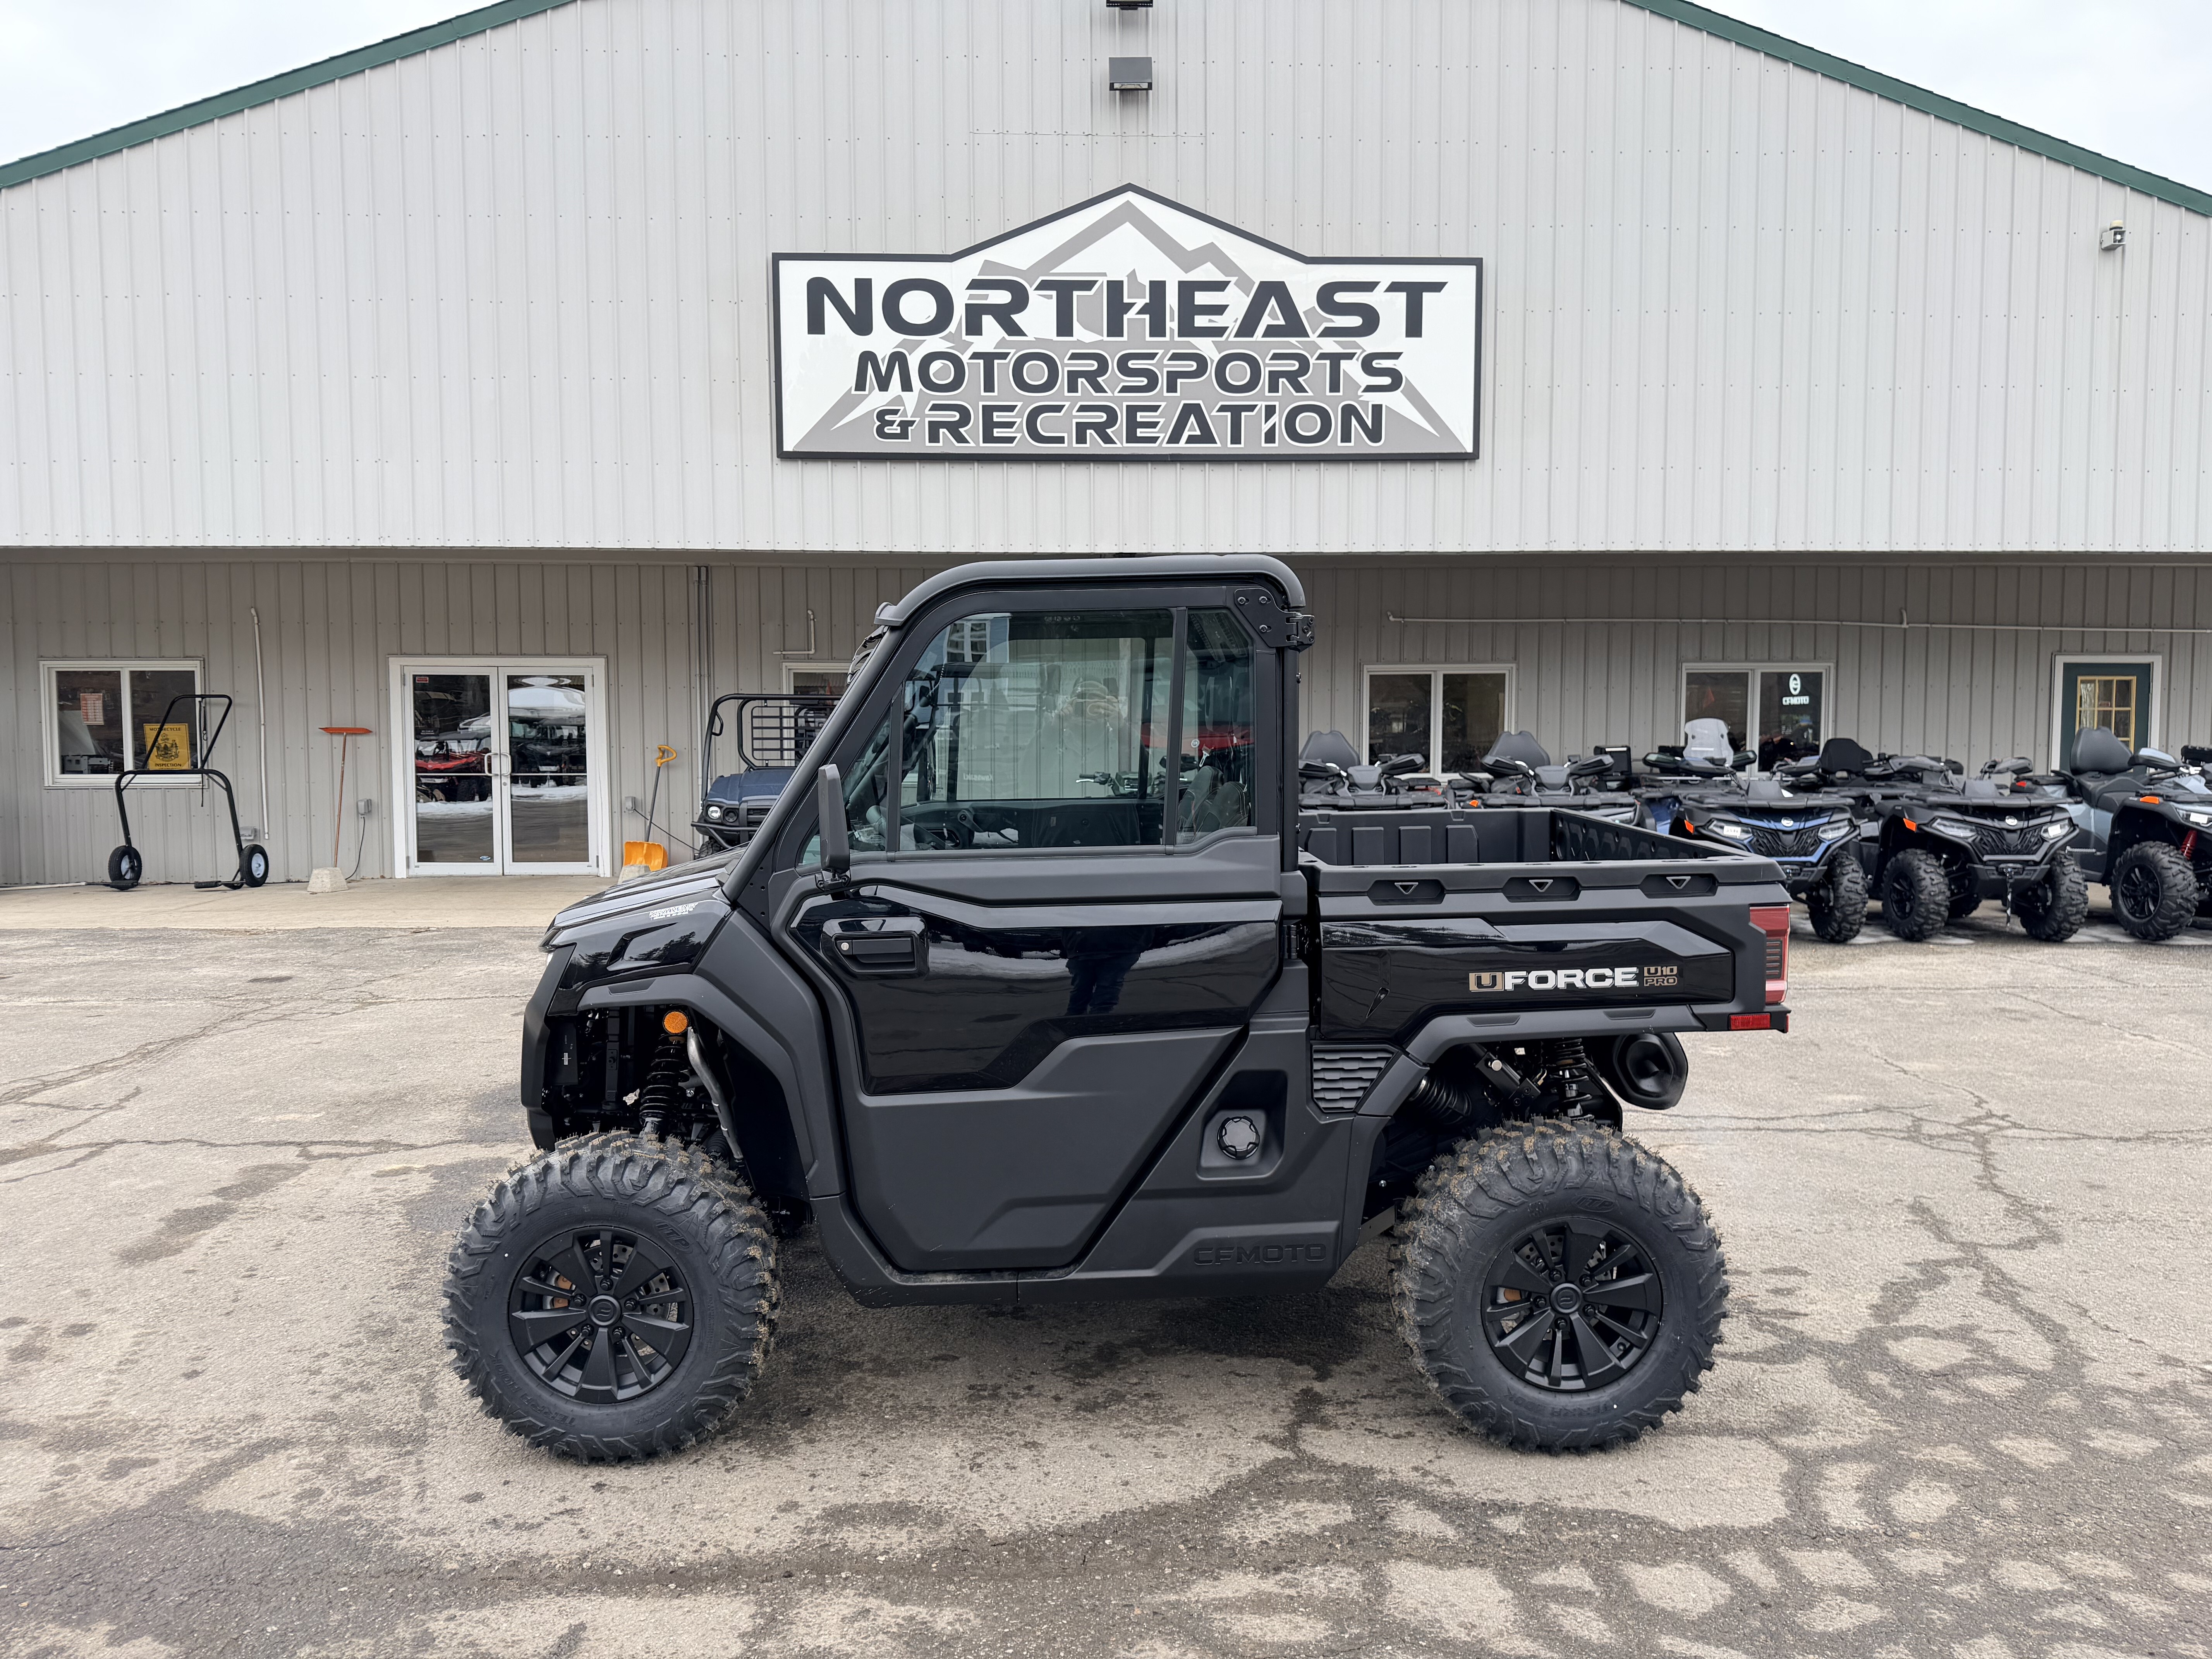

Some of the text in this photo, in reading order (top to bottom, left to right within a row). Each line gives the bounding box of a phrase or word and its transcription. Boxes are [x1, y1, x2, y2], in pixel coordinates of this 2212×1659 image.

[807, 277, 1448, 337] NORTHEAST
[855, 351, 1403, 393] MOTORSPORTS
[1783, 696, 1809, 705] CFMOTO
[1469, 967, 1639, 992] UFORCE
[1644, 966, 1677, 976] U10
[1644, 976, 1677, 986] PRO
[1574, 1196, 1613, 1209] ITP
[655, 1222, 690, 1249] ITP
[1194, 1243, 1326, 1265] CFMOTO
[489, 1348, 522, 1393] HOOK
